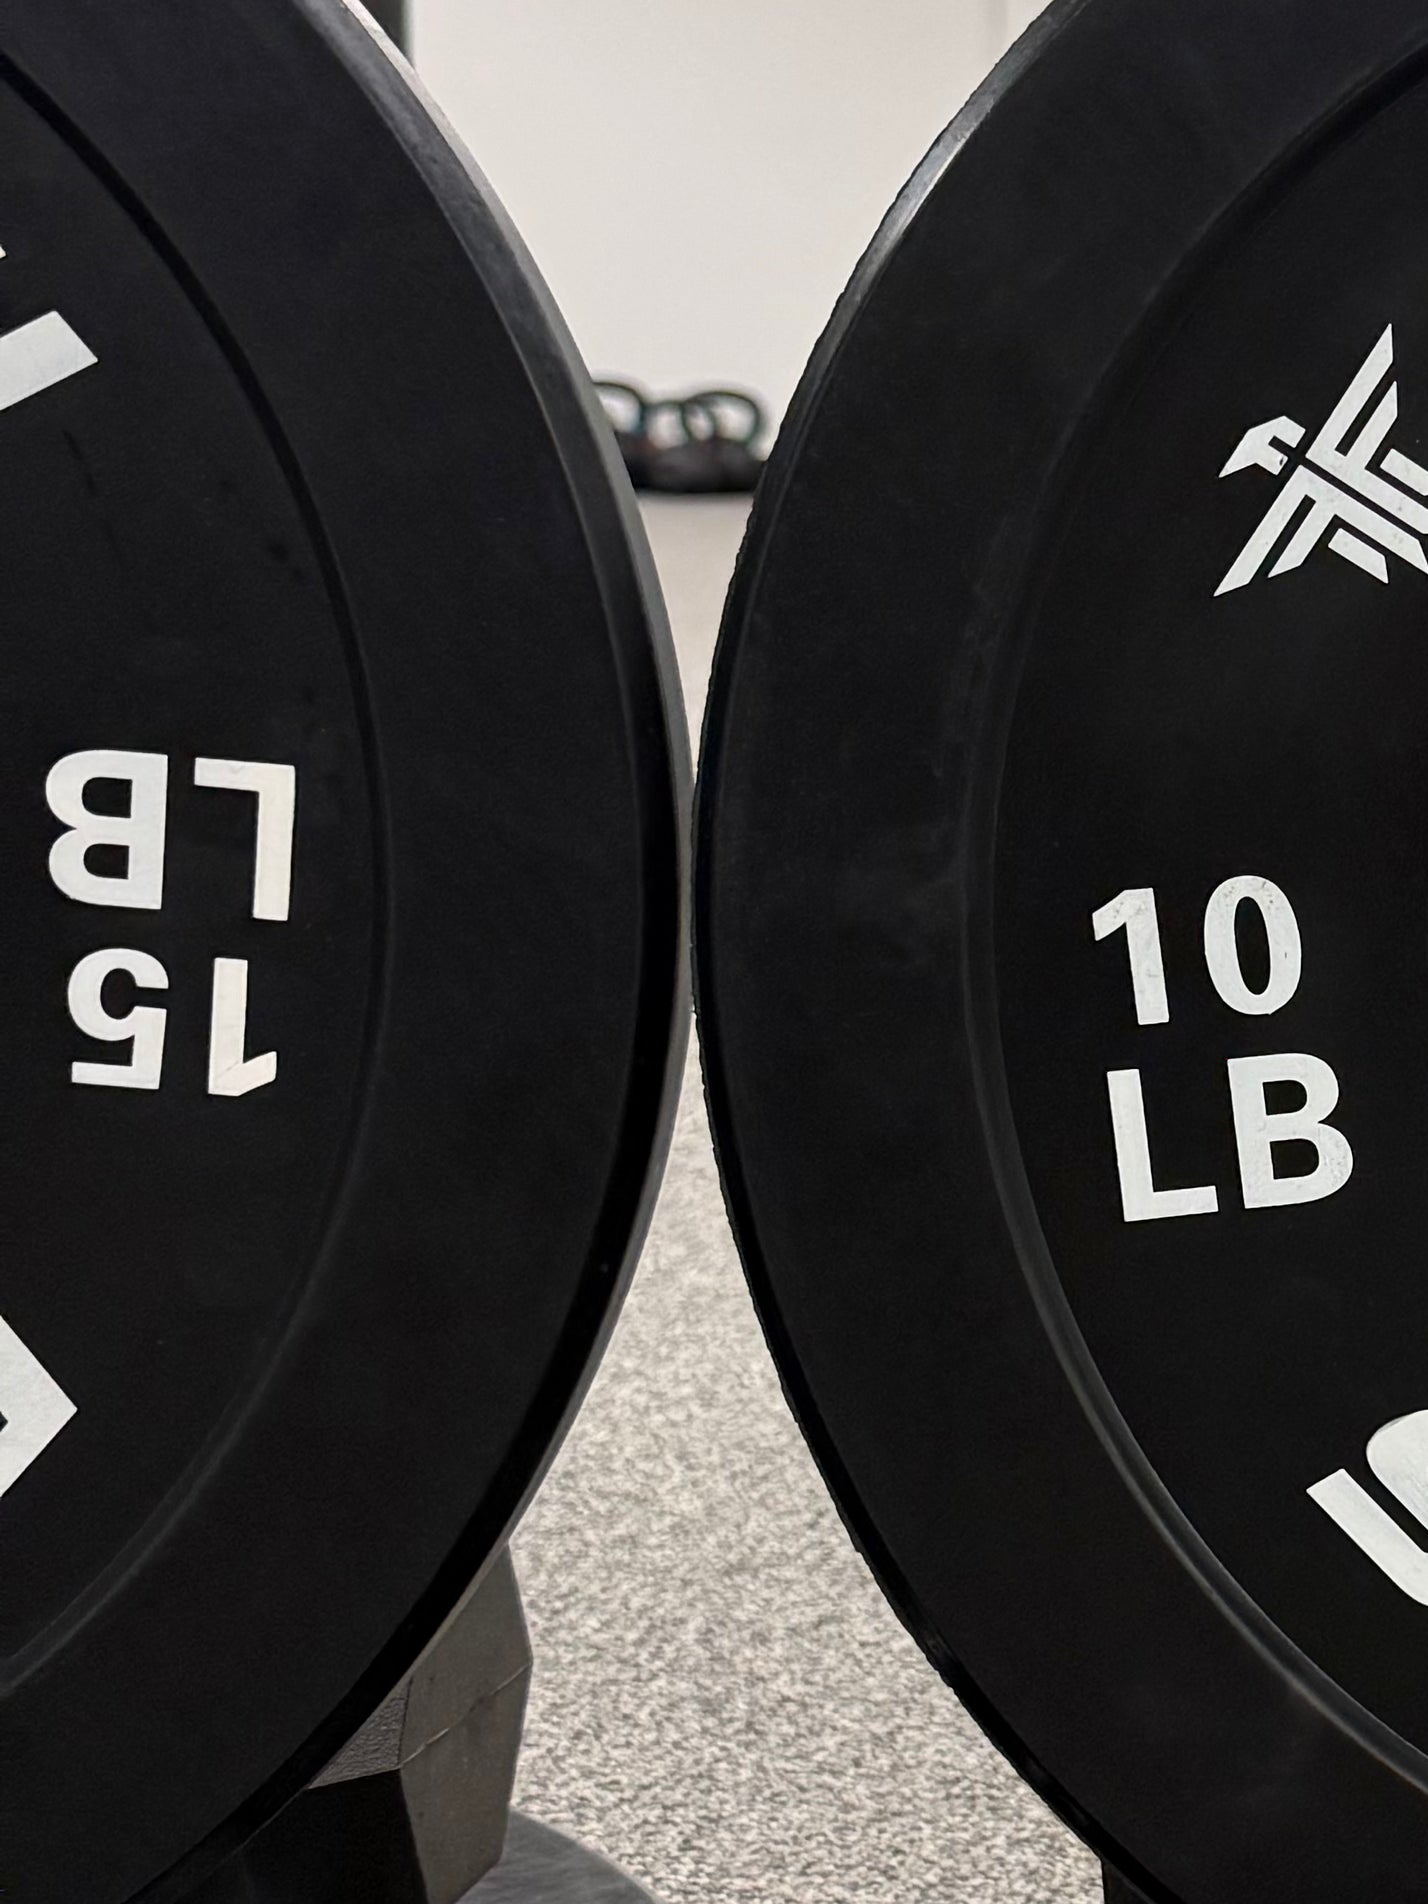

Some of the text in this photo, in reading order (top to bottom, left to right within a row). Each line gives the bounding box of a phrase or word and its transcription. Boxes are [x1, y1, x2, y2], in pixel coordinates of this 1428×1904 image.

[45, 749, 296, 922] LB
[67, 948, 277, 1097] 15
[1092, 875, 1302, 1026] 10
[1106, 1052, 1354, 1222] LB
